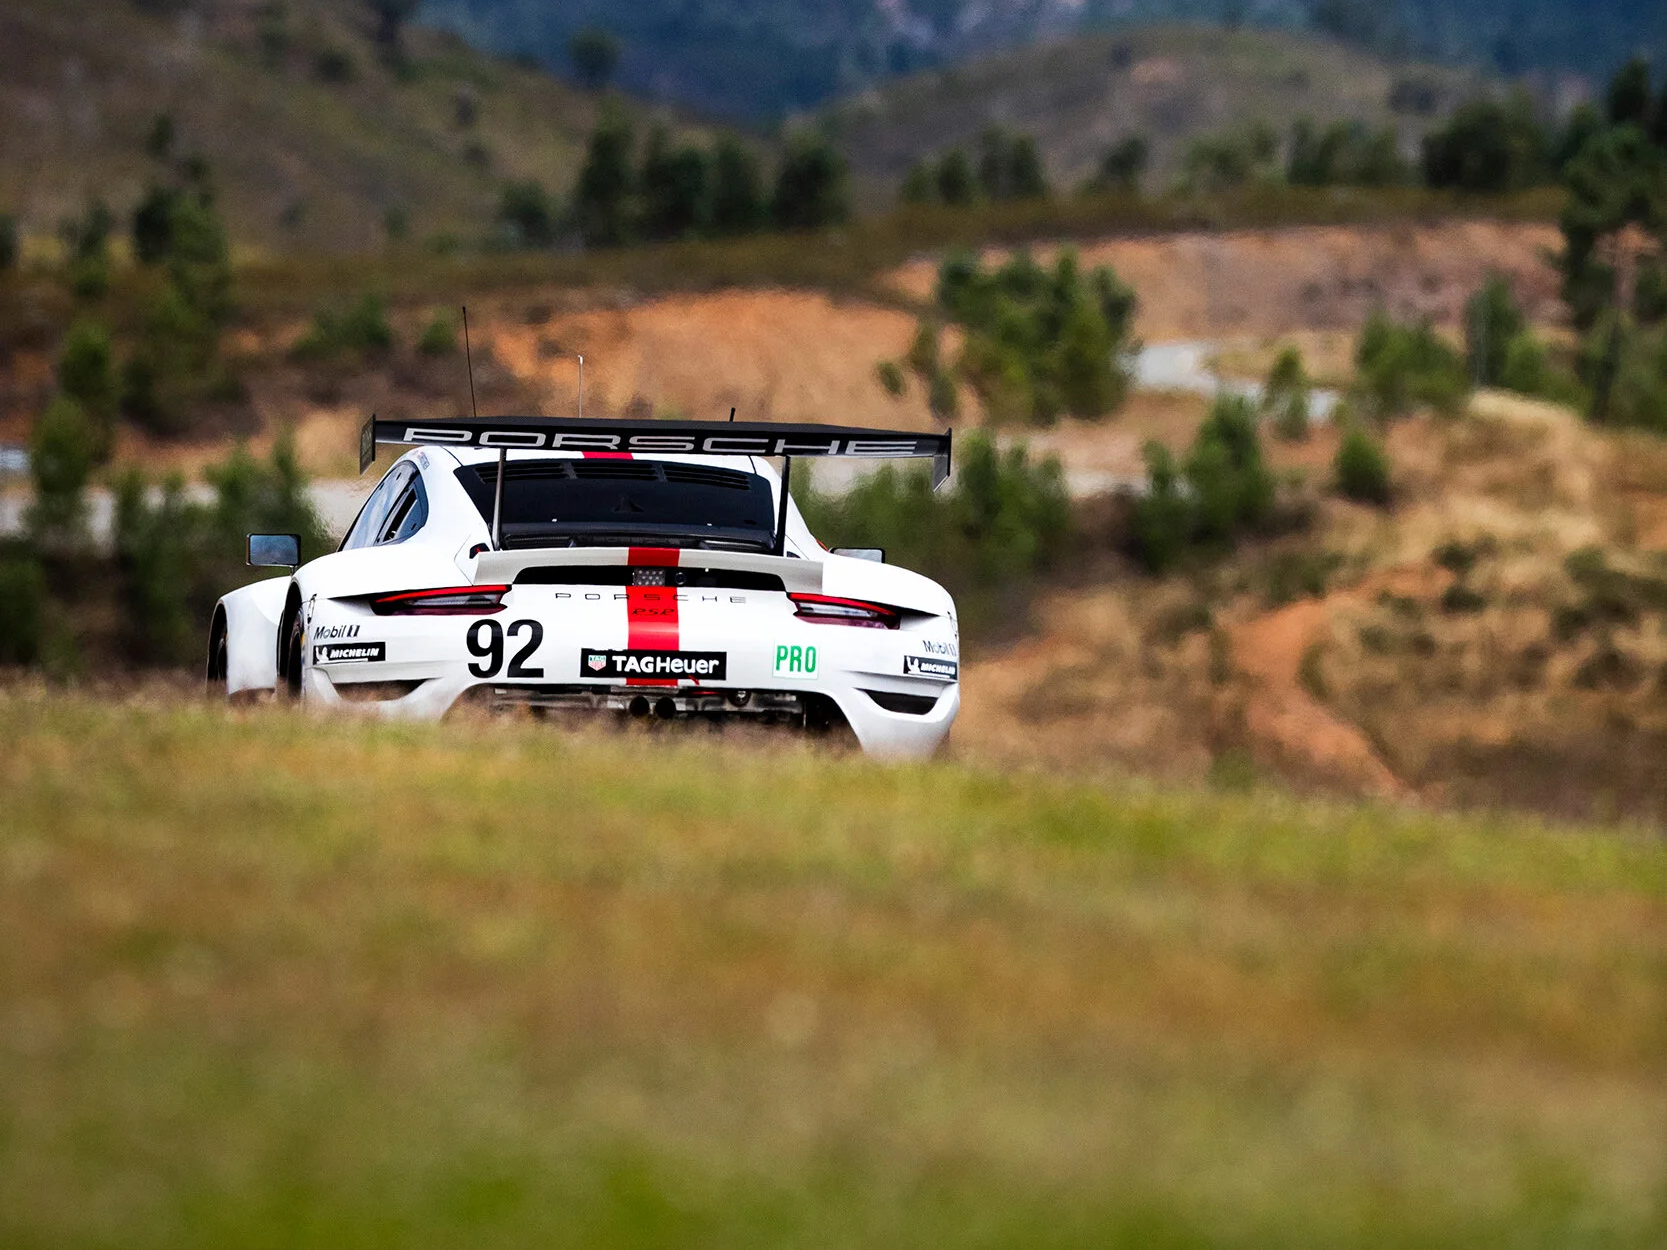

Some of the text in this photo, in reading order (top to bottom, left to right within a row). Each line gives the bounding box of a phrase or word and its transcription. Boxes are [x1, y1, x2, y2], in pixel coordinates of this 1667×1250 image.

[402, 427, 917, 456] PORSCHE
[555, 593, 747, 603] PORSCHE
[314, 625, 347, 640] Mobil
[330, 648, 379, 659] MICHELIN
[466, 619, 544, 678] 92
[776, 645, 816, 673] PRO
[921, 662, 956, 675] MICHELIN
